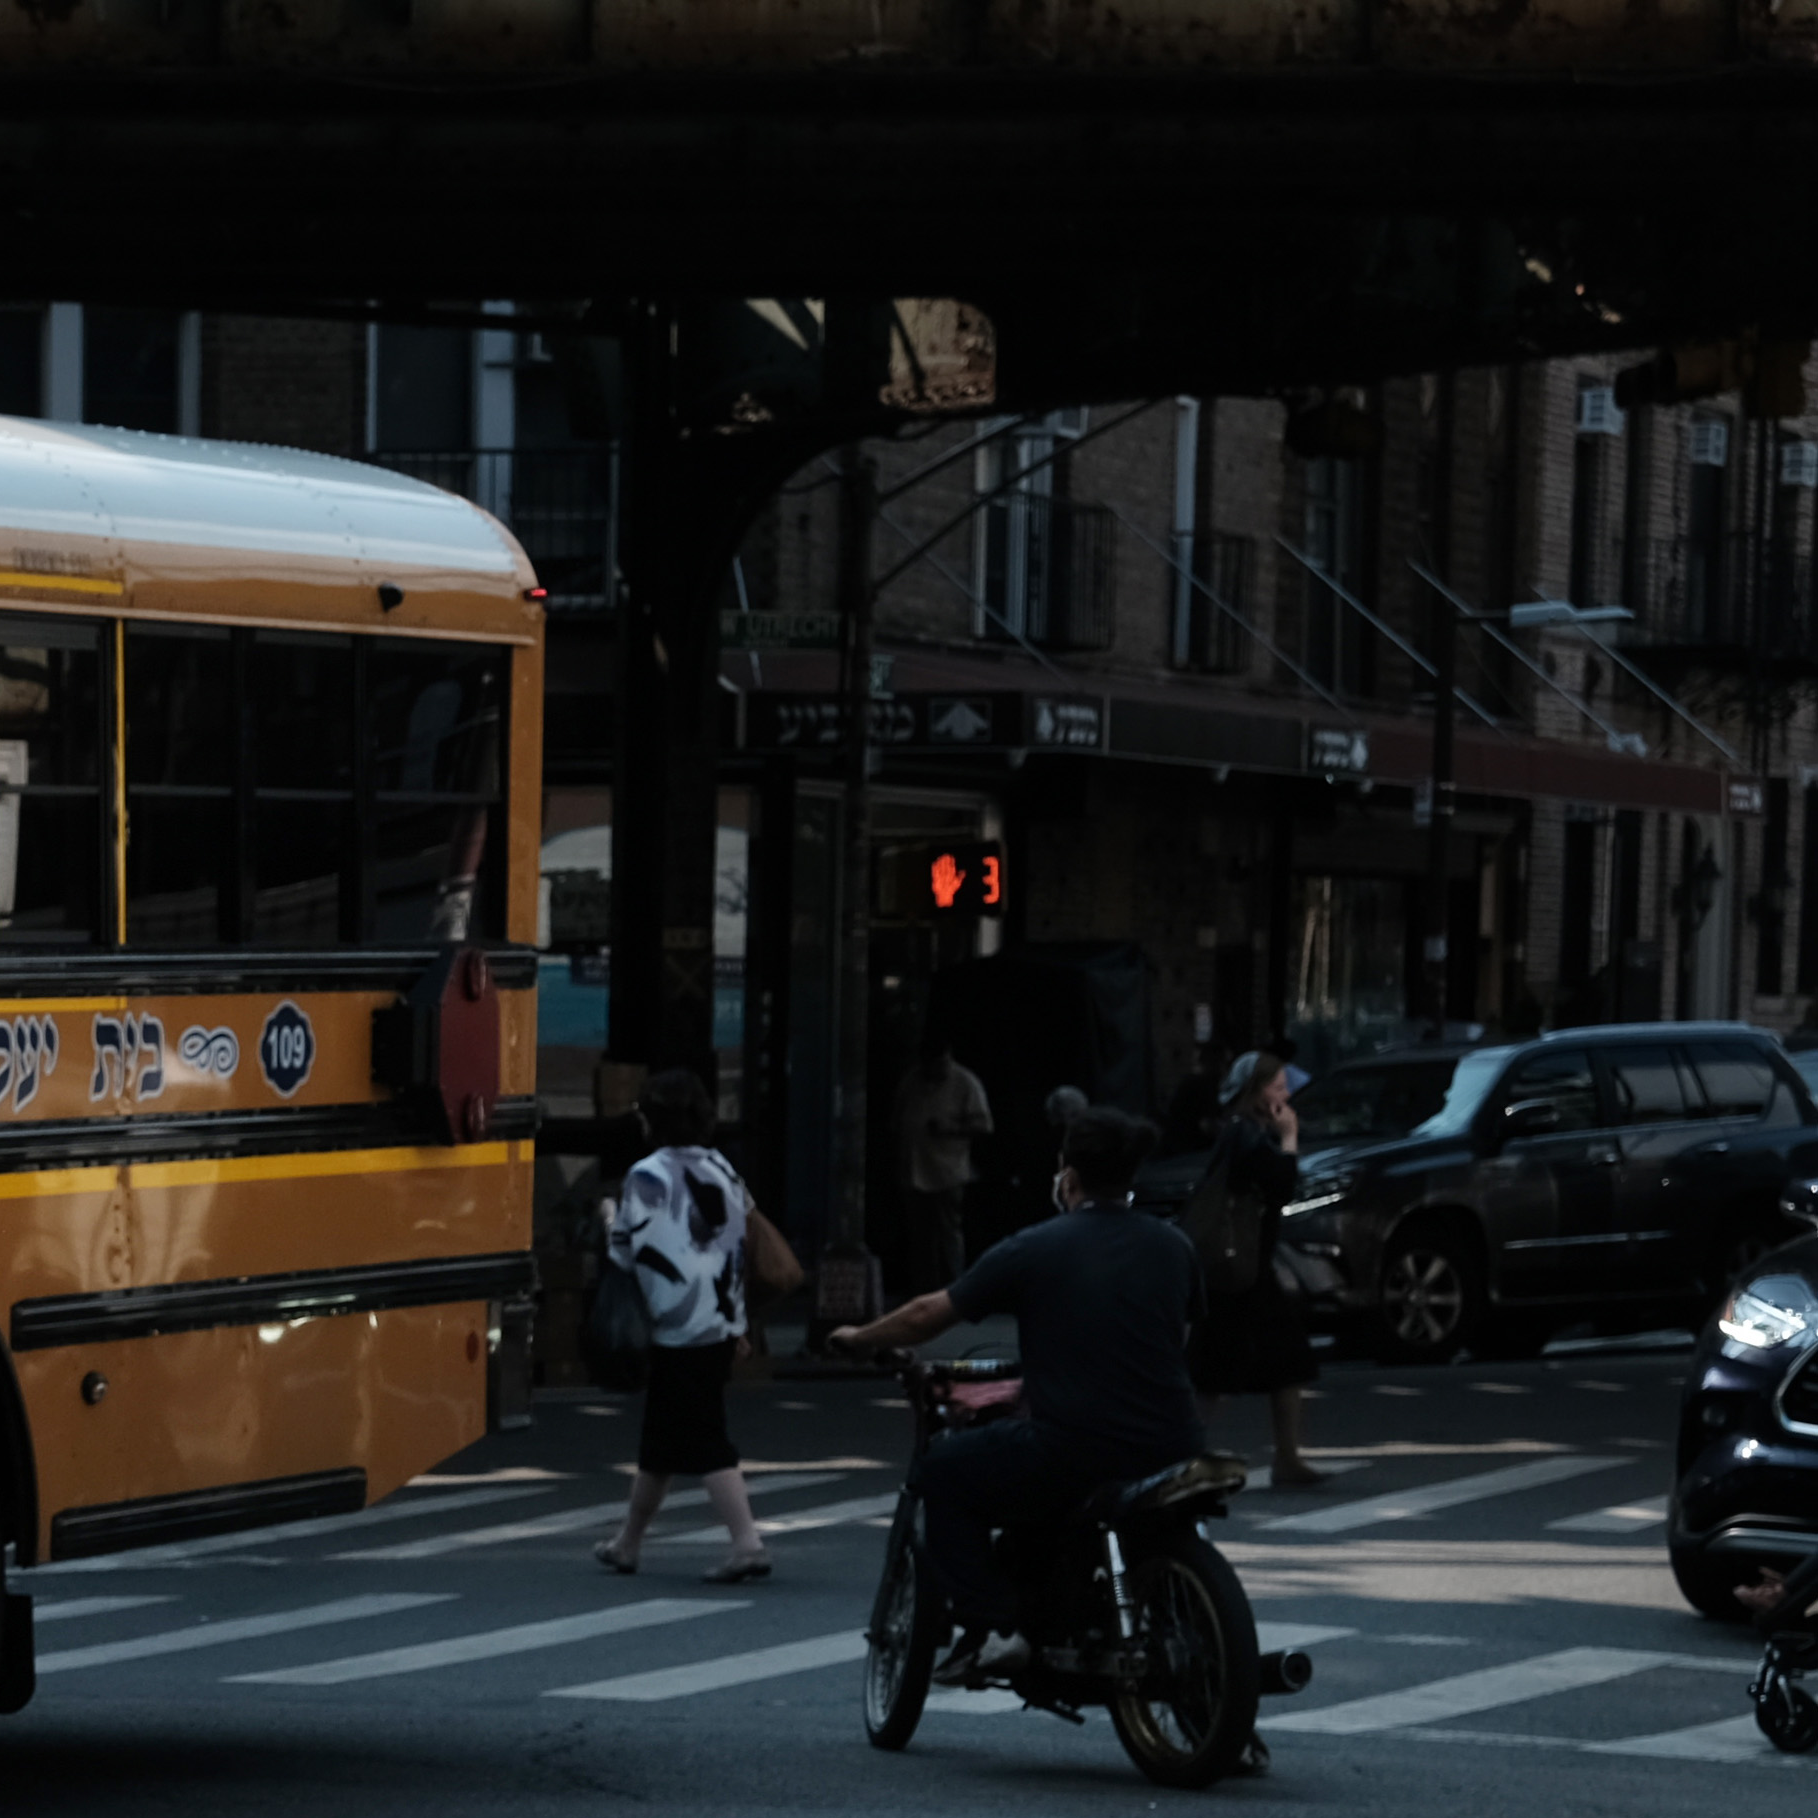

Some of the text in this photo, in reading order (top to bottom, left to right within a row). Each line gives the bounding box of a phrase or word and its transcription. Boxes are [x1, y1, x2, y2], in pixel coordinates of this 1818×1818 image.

[982, 856, 999, 904] 3
[89, 1011, 165, 1102] בית
[267, 1025, 306, 1070] 109
